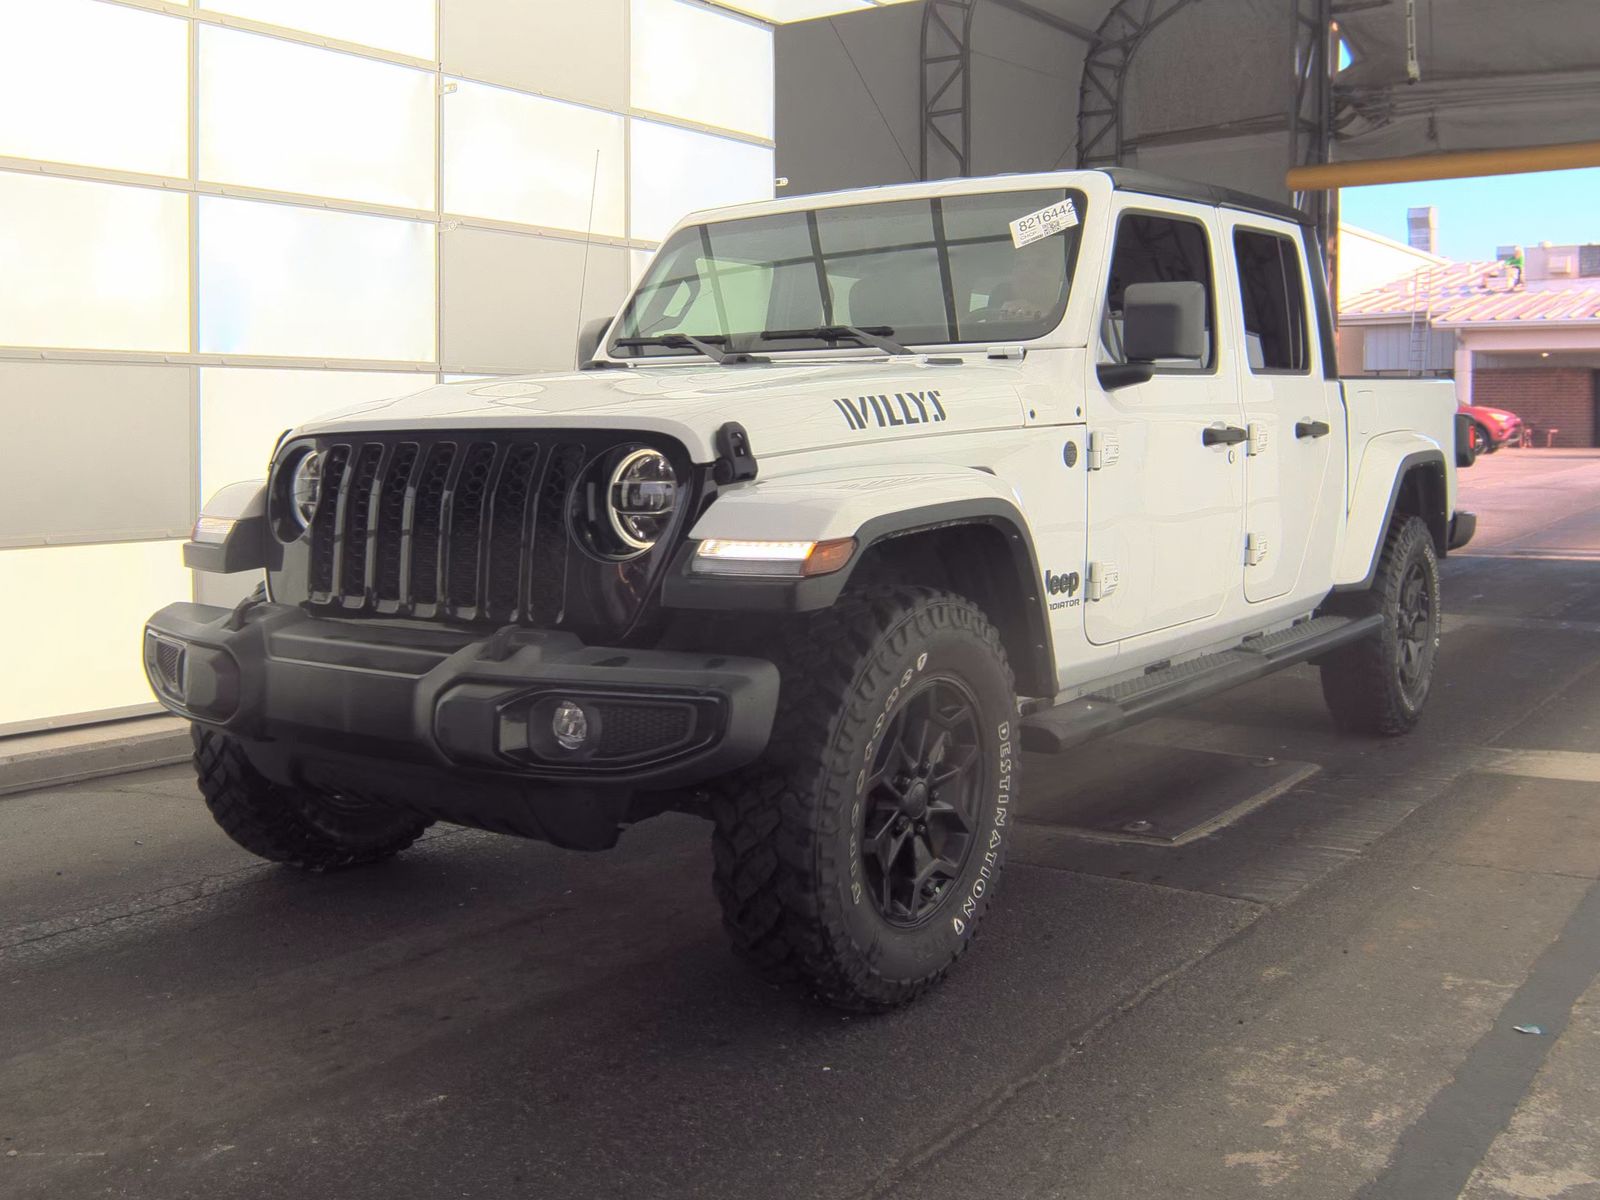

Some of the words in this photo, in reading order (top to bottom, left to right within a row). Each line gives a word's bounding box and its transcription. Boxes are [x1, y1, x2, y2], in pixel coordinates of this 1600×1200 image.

[1018, 202, 1075, 232] 8216442
[832, 390, 946, 430] WILLYS
[963, 721, 1012, 919] DESTINATION
